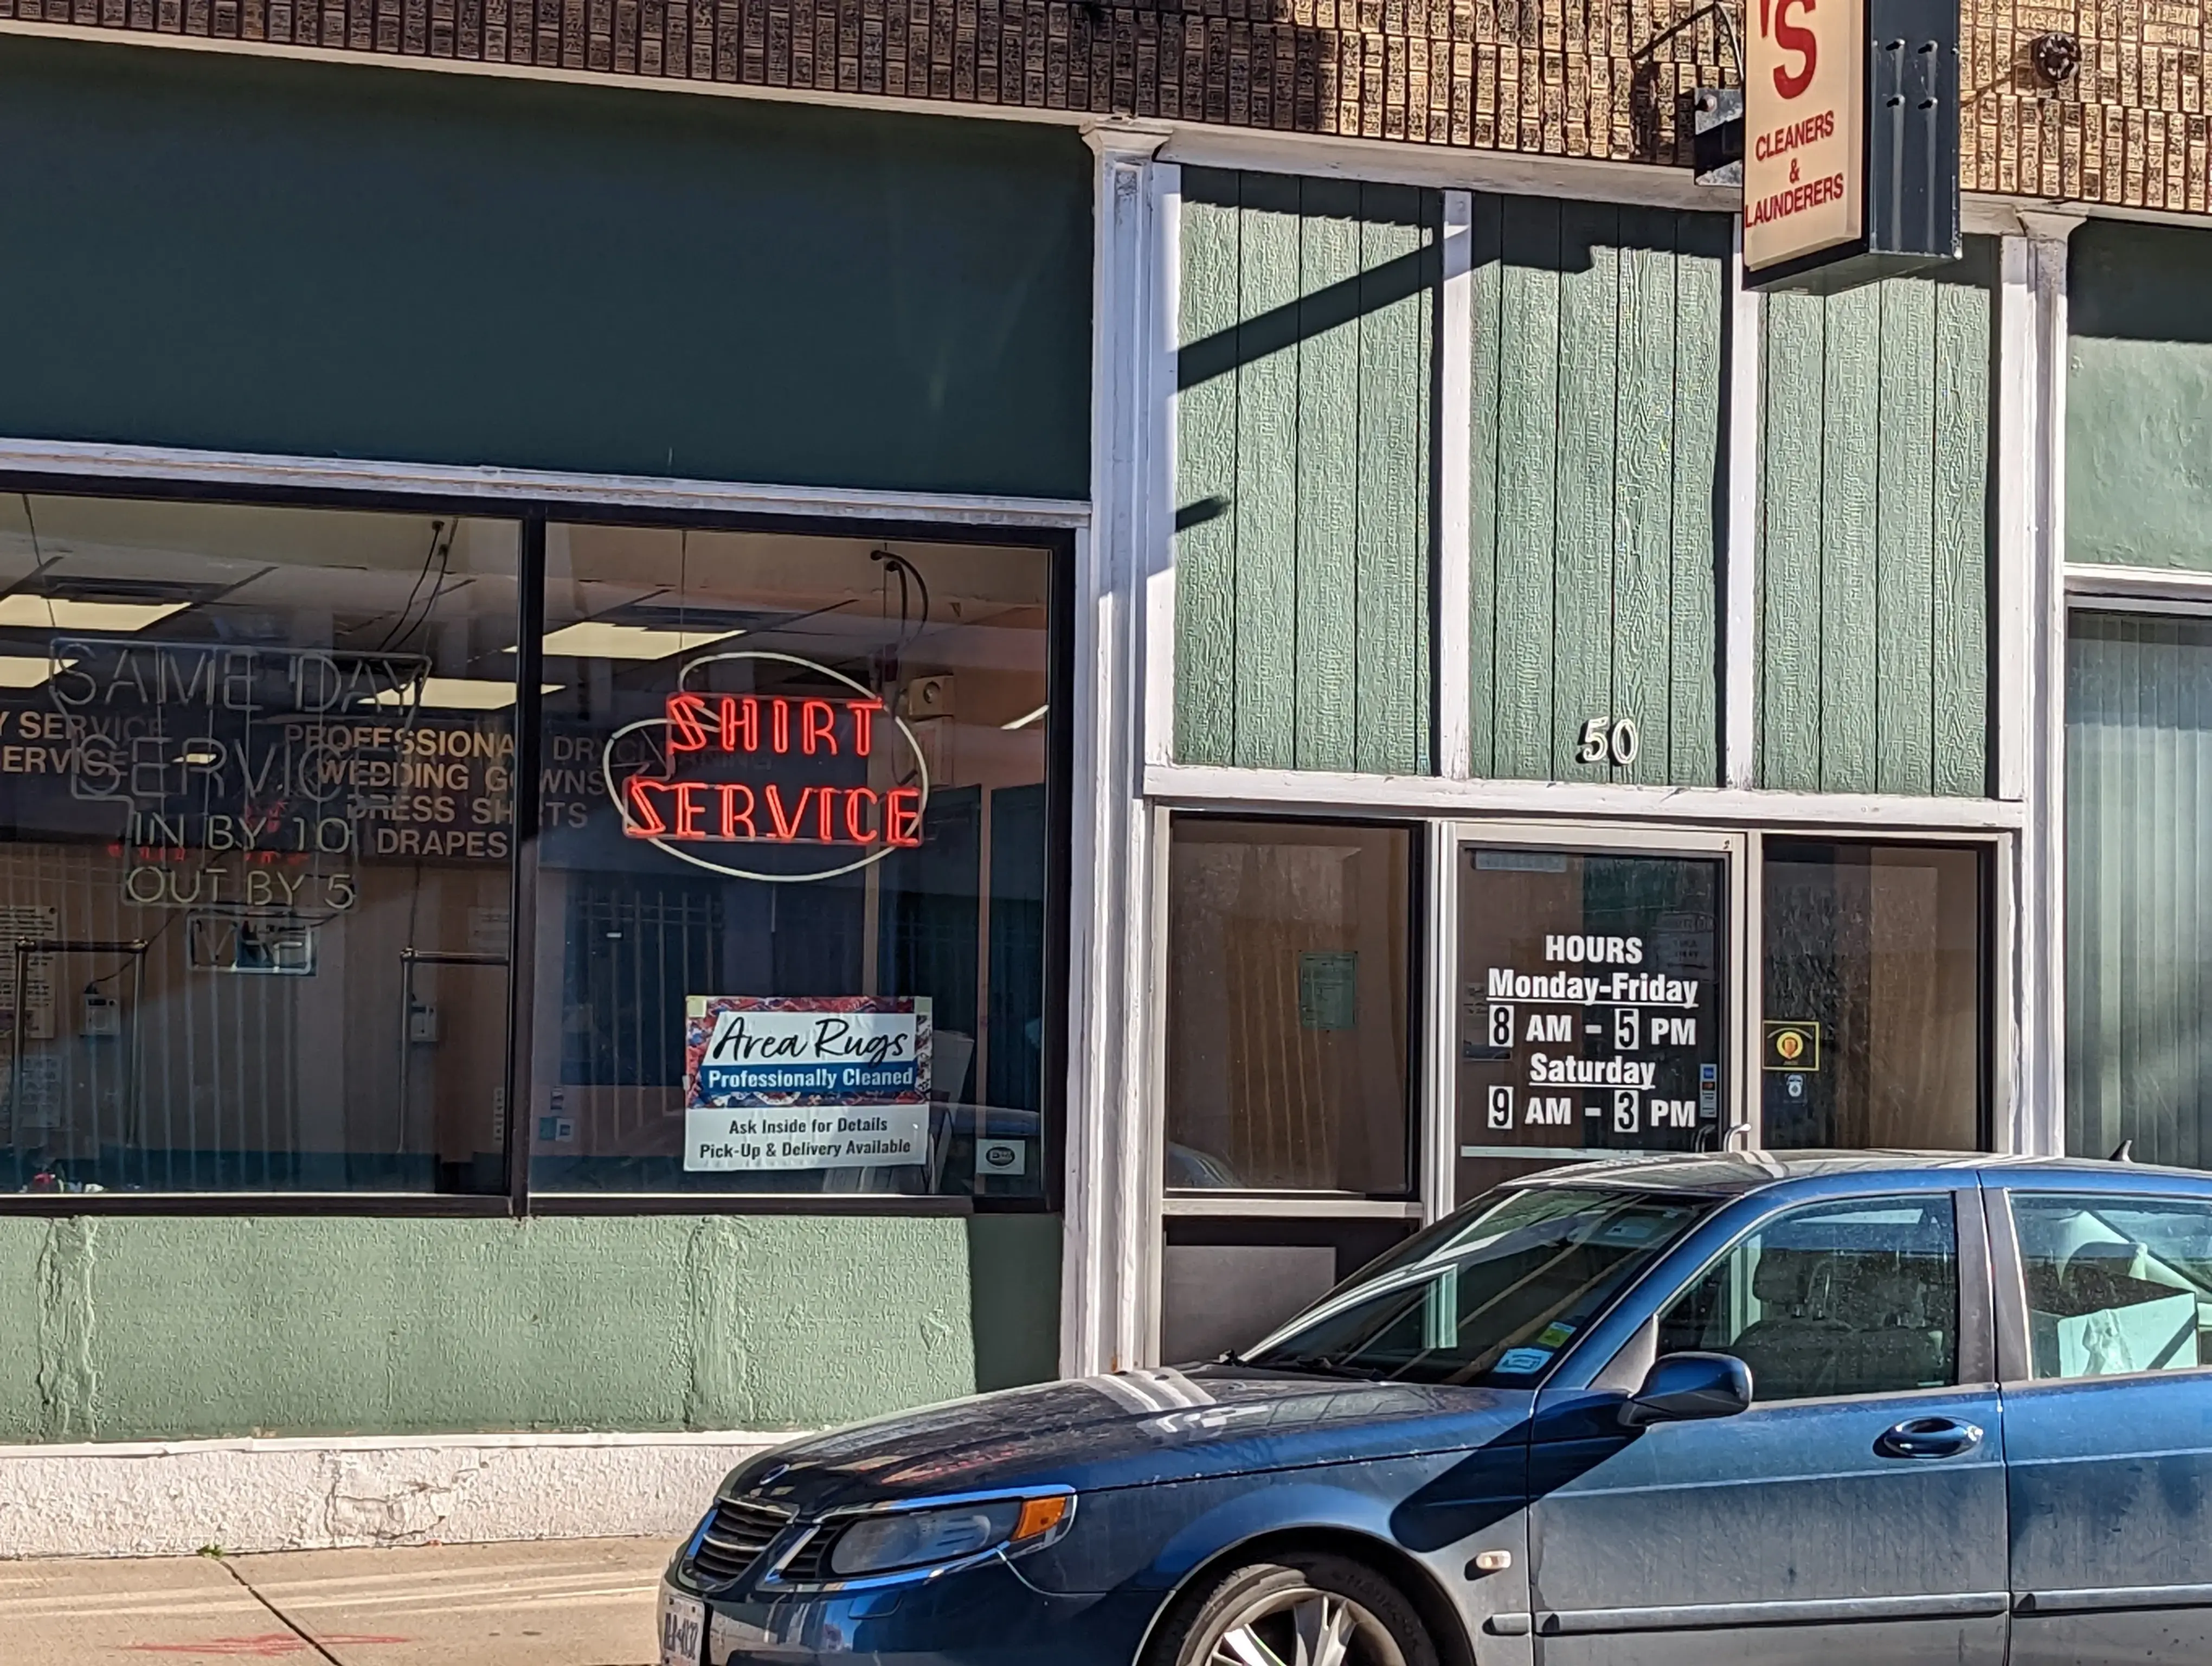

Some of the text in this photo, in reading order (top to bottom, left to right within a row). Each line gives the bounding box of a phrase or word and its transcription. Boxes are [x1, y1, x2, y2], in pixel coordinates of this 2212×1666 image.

[1755, 110, 1834, 161] CLEANERS
[1789, 158, 1799, 183] &
[1745, 173, 1843, 228] LAUNDERERS
[58, 643, 425, 715] SAME DAY
[285, 725, 516, 758] PROFESSIONA
[668, 695, 883, 755] SHIRT
[1583, 716, 1638, 764] 50
[77, 732, 400, 808] SERVICE
[317, 759, 606, 795] WEDDING GWNS
[347, 793, 588, 828] DRESS SHTS
[626, 778, 919, 847] SERVICE
[136, 812, 350, 854] IN BY 10
[377, 828, 508, 858] DRAPES
[127, 866, 355, 910] OUT BY 5
[1545, 935, 1643, 964] HOURS
[1488, 968, 1699, 1008] Monday-Friday
[712, 1016, 909, 1067] Area Rugs
[1491, 1005, 1512, 1048] 8
[1526, 1015, 1572, 1042] AM
[1616, 1010, 1637, 1049] 5
[1651, 1018, 1696, 1046] PM
[708, 1066, 914, 1091] Professionally Cleaned
[1530, 1053, 1655, 1087] Saturday
[729, 1116, 888, 1135] Ask Inside for Details
[1490, 1087, 1512, 1129] 9
[1525, 1098, 1571, 1125] AM
[1616, 1091, 1637, 1131] 3
[1651, 1100, 1696, 1128] PM
[700, 1138, 911, 1160] Pick-Up & Delivery Available
